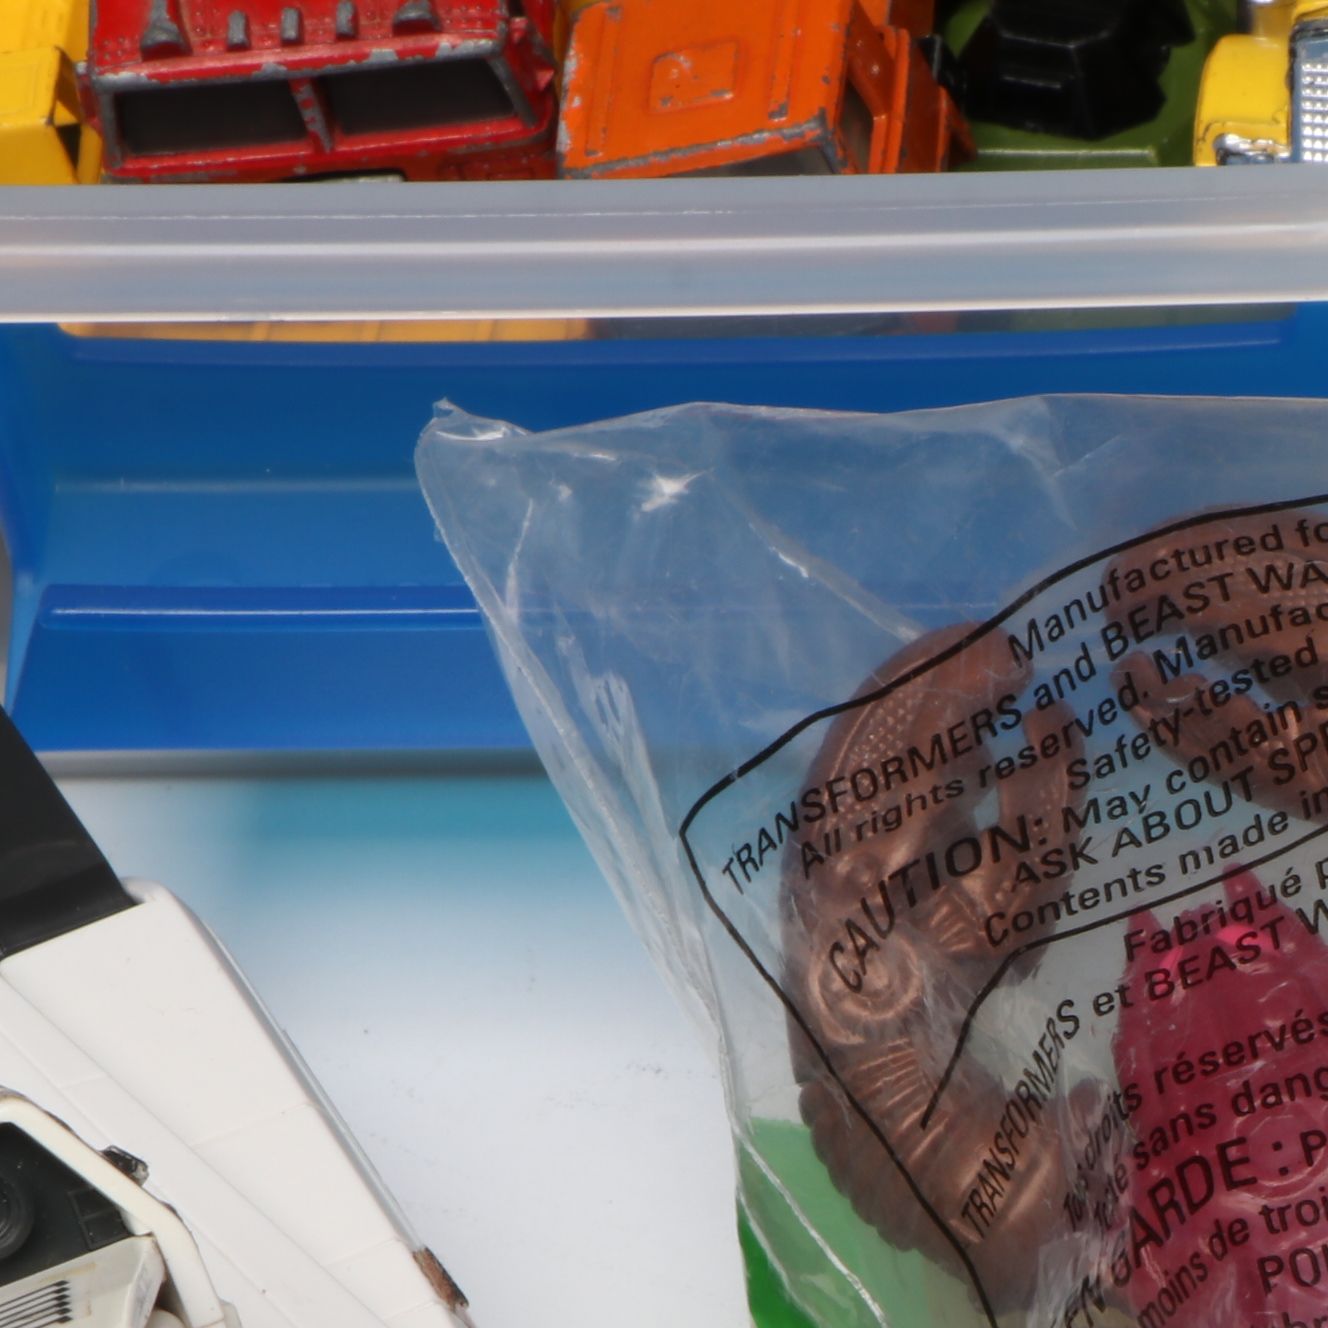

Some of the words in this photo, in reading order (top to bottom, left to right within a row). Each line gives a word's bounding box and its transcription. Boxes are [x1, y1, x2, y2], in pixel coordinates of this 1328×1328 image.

[1008, 523, 1284, 668] Manufactured
[722, 702, 1021, 895] TRANSFORMERS
[1033, 646, 1096, 710] and
[1101, 573, 1234, 661] BEAST
[799, 828, 841, 879] All
[856, 778, 965, 842] rights
[979, 689, 1150, 790] reserved.
[1069, 641, 1318, 791] Safety-tested
[829, 815, 1048, 995] CAUTION:
[1061, 785, 1151, 835] May
[1166, 703, 1300, 795] contain
[983, 862, 1167, 948] Contents
[1178, 810, 1290, 874] made
[1011, 842, 1096, 893] ASK
[1110, 768, 1256, 858] ABOUT
[1092, 983, 1133, 1017] et
[1143, 917, 1286, 1000] BEAST
[1123, 866, 1302, 961] Fabriqué
[1133, 1102, 1218, 1172] sans
[1208, 1216, 1250, 1262] de
